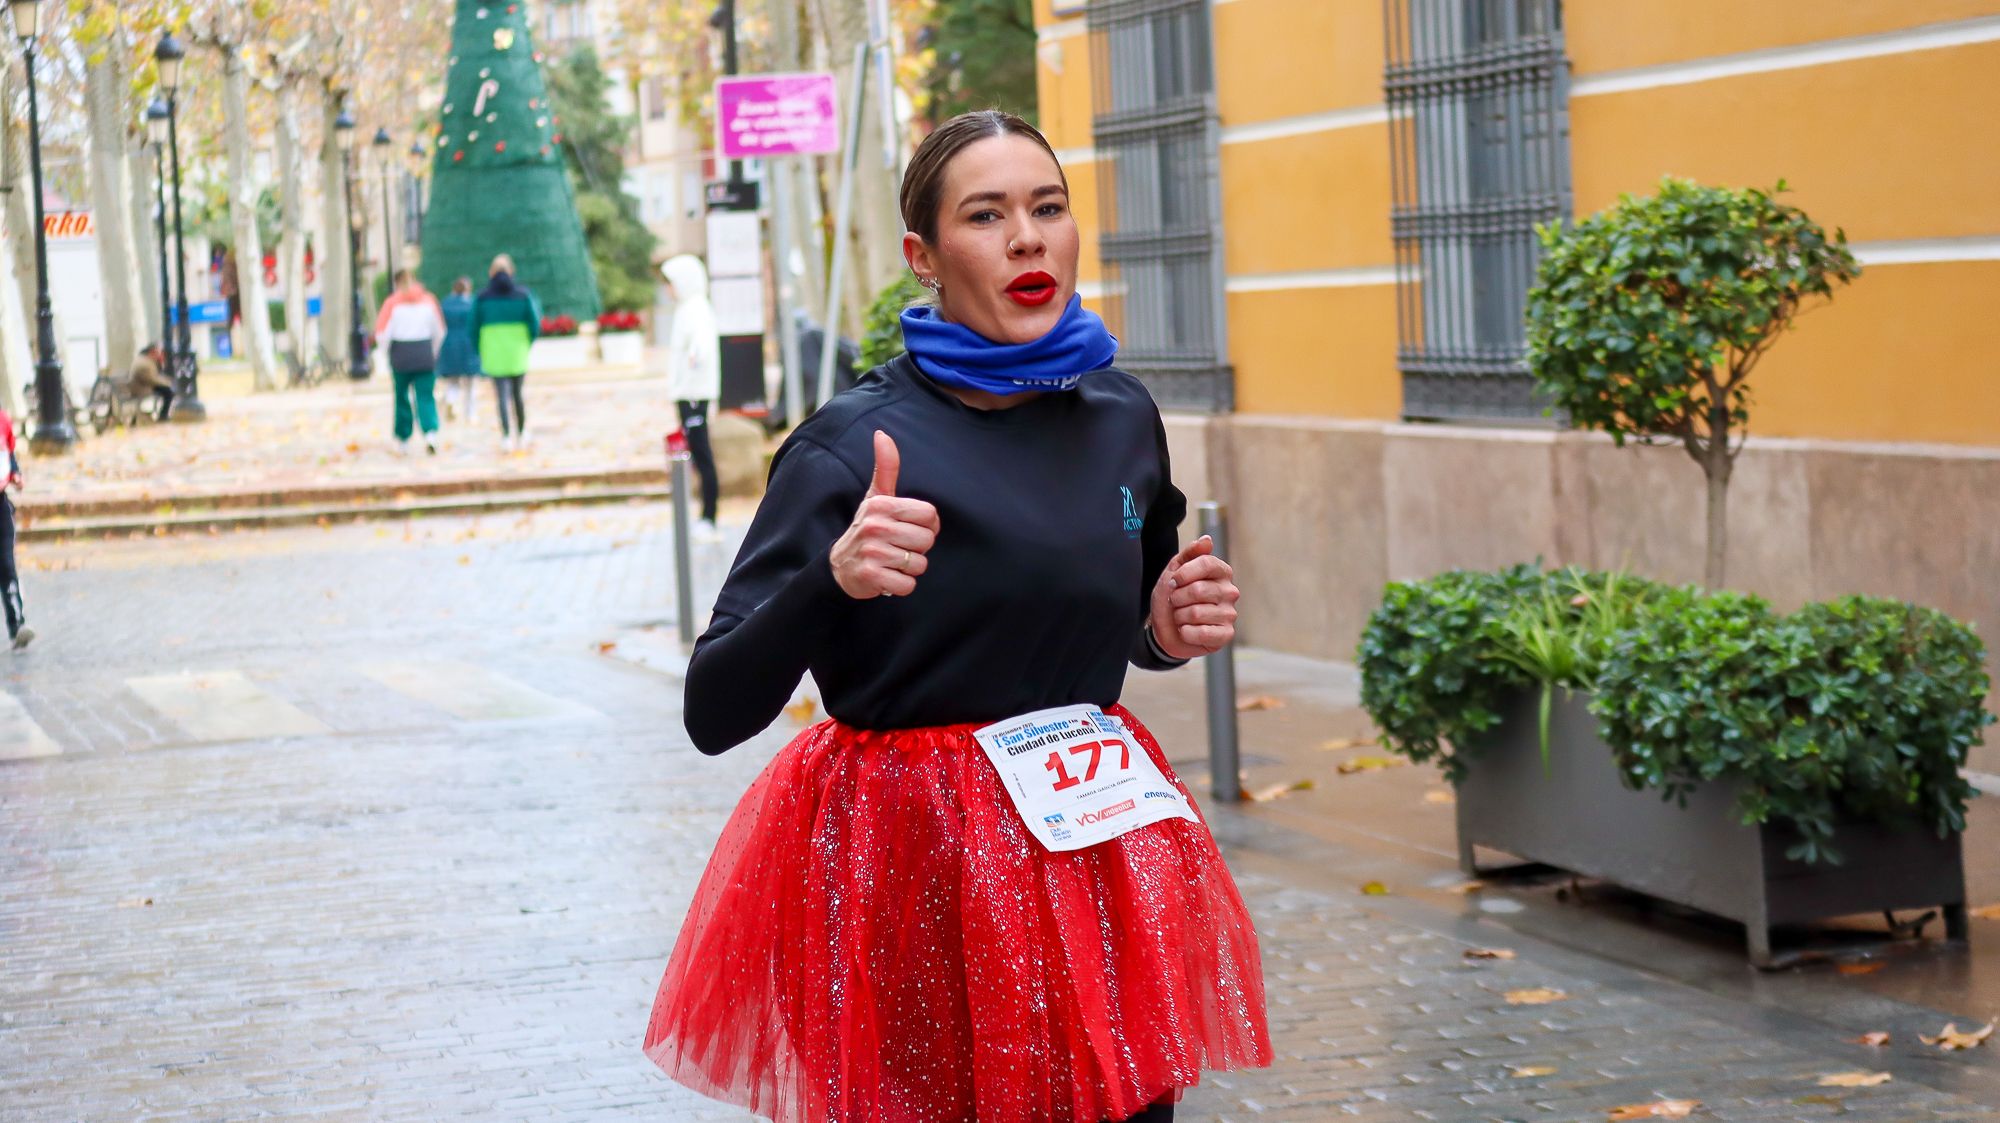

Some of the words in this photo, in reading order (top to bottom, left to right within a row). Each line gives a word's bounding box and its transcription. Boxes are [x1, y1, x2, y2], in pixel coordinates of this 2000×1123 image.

[1001, 733, 1024, 746] San
[1024, 720, 1069, 739] Silvestre
[1007, 735, 1046, 756] Ciudad
[1046, 734, 1060, 743] de
[1059, 727, 1096, 740] Lucena
[1044, 739, 1130, 792] 177
